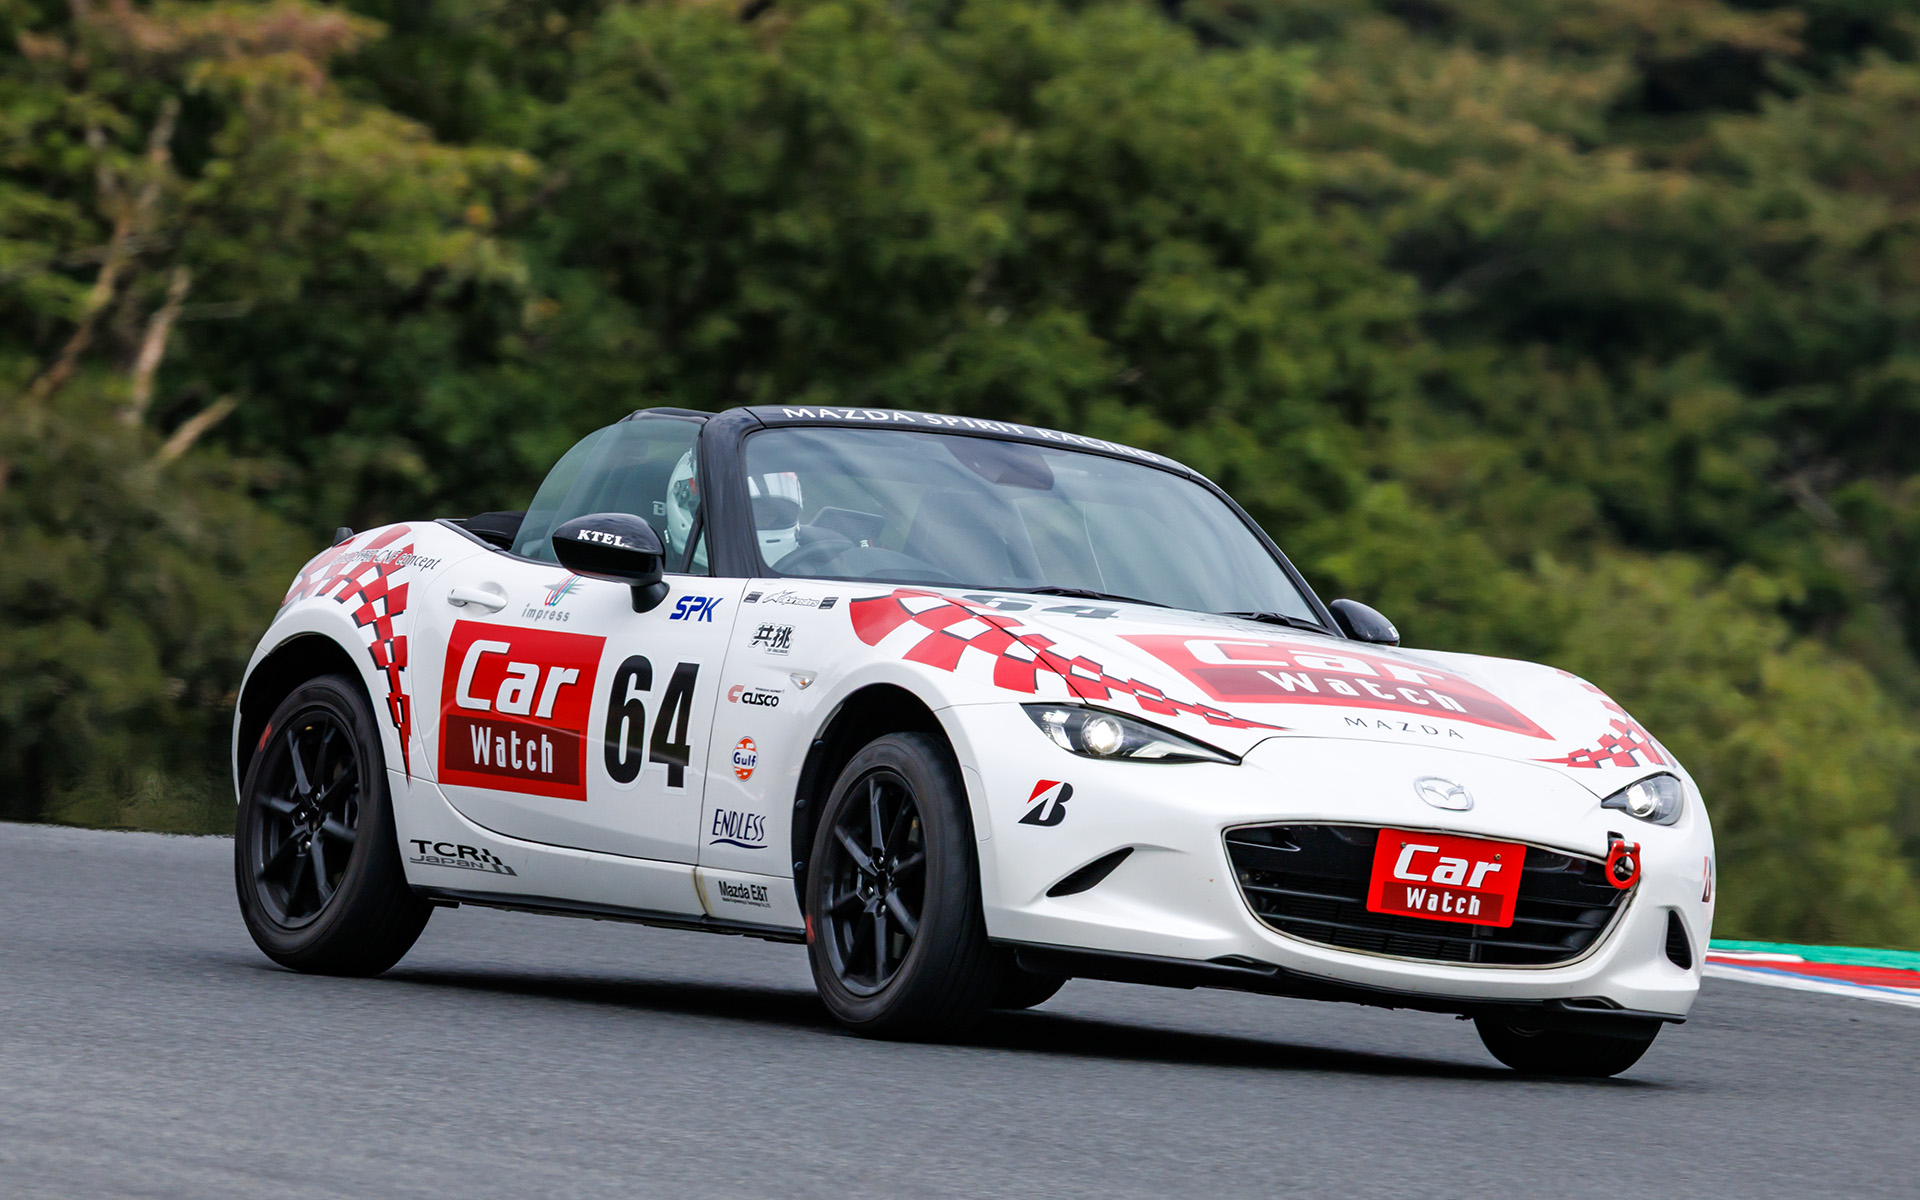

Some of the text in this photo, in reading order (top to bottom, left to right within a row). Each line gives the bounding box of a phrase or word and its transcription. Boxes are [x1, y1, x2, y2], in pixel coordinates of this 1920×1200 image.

[782, 408, 1160, 461] MAZDA SPIRIT RACING
[577, 529, 625, 547] KTEL
[396, 553, 442, 571] concept
[522, 603, 570, 622] impress
[669, 595, 724, 623] SPK
[1183, 638, 1447, 686] Car
[456, 639, 580, 719] Car
[1257, 670, 1467, 714] Watch
[604, 654, 700, 788] 64
[1344, 716, 1465, 740] MAZDA
[470, 724, 553, 774] Watch
[733, 751, 757, 767] Gulf
[712, 808, 766, 842] ENDLESS
[410, 839, 482, 861] TCR
[1393, 843, 1502, 889] Car
[718, 880, 769, 902] Mazda E&T
[1404, 886, 1482, 917] Watch
